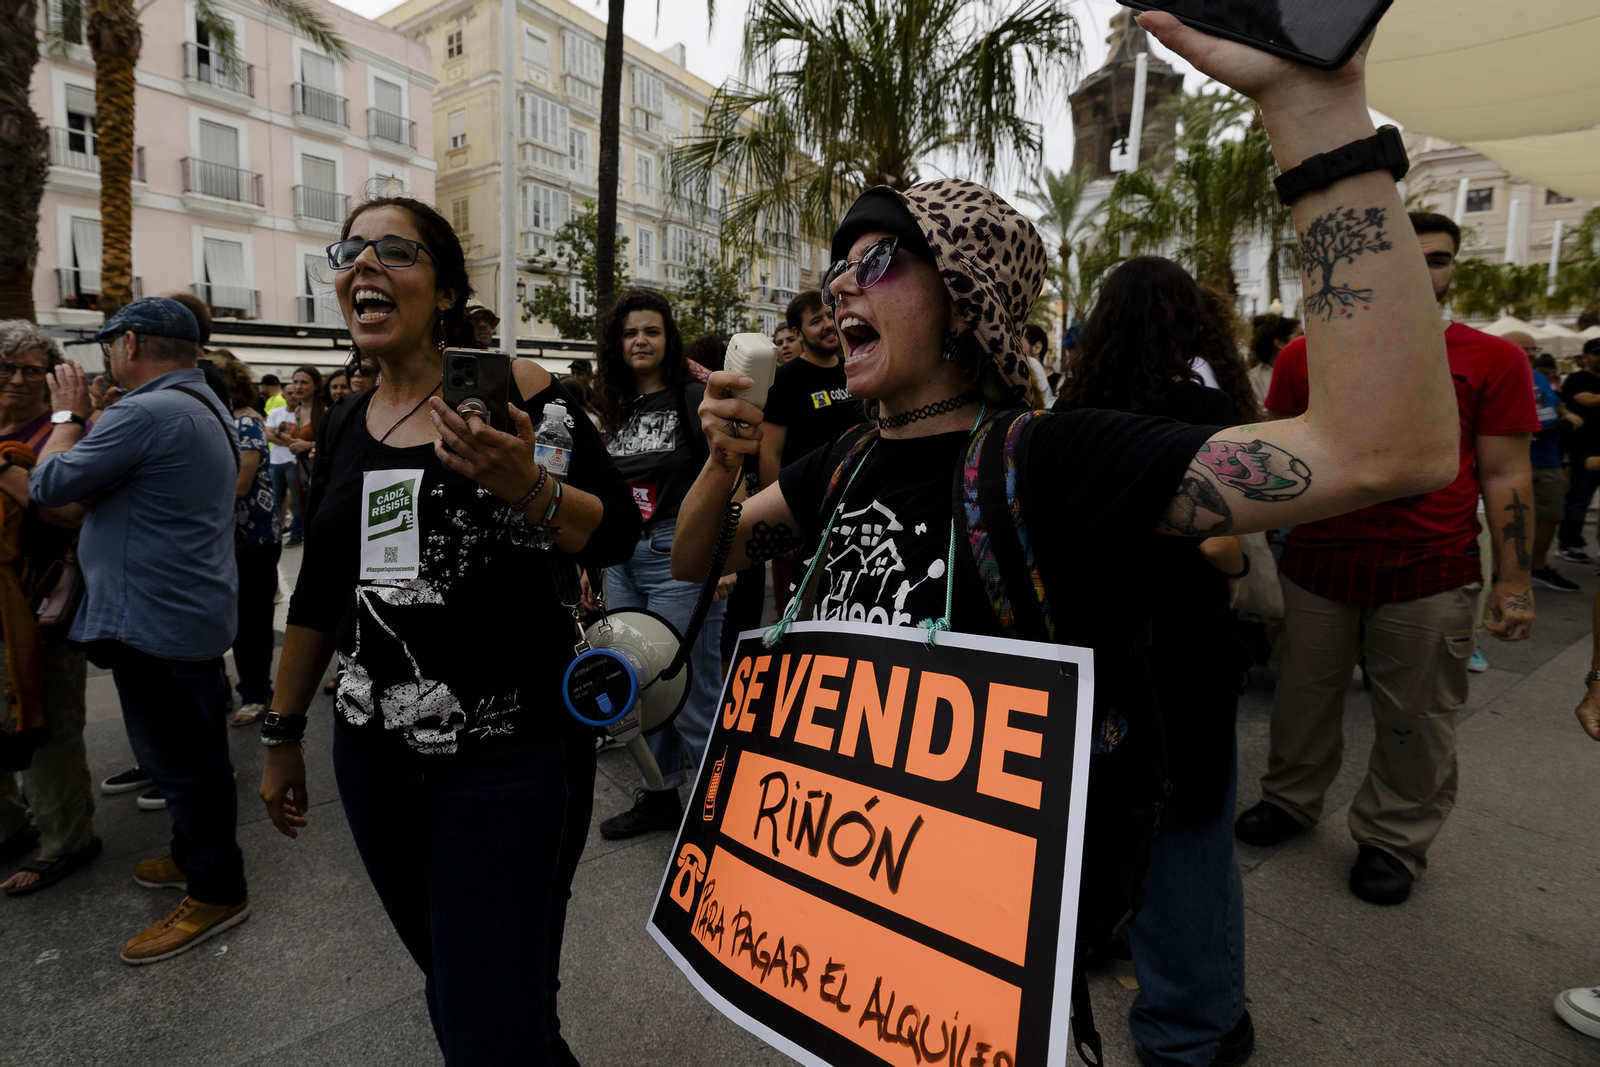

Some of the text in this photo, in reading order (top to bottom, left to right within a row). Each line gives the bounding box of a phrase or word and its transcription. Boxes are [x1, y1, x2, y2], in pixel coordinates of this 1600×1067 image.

[372, 495, 410, 517] RESISTE
[377, 487, 405, 505] CÁDIZ
[722, 654, 1050, 810] SE VENDE
[695, 879, 725, 954] PARA
[731, 904, 811, 992] PAGAR
[820, 956, 851, 1013] EL
